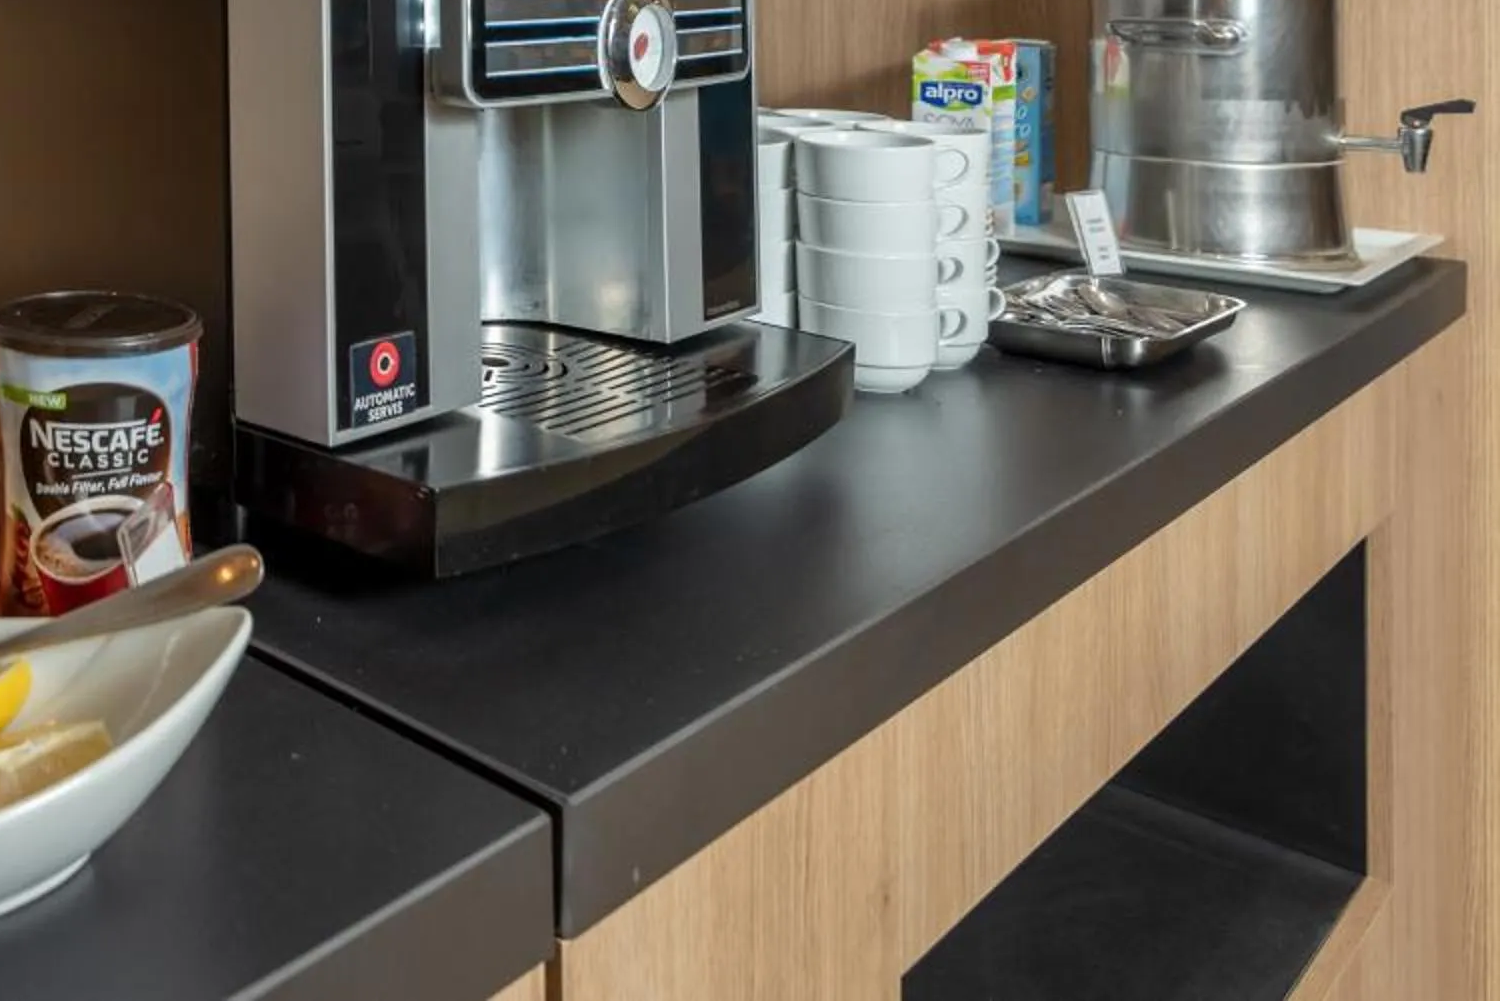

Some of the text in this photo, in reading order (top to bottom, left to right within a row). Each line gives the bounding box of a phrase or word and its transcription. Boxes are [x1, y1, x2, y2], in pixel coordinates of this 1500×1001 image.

[925, 82, 978, 104] alpro
[353, 382, 417, 411] AUTOMATIC
[367, 400, 404, 422] SERVIS
[46, 448, 149, 469] CLASSIC
